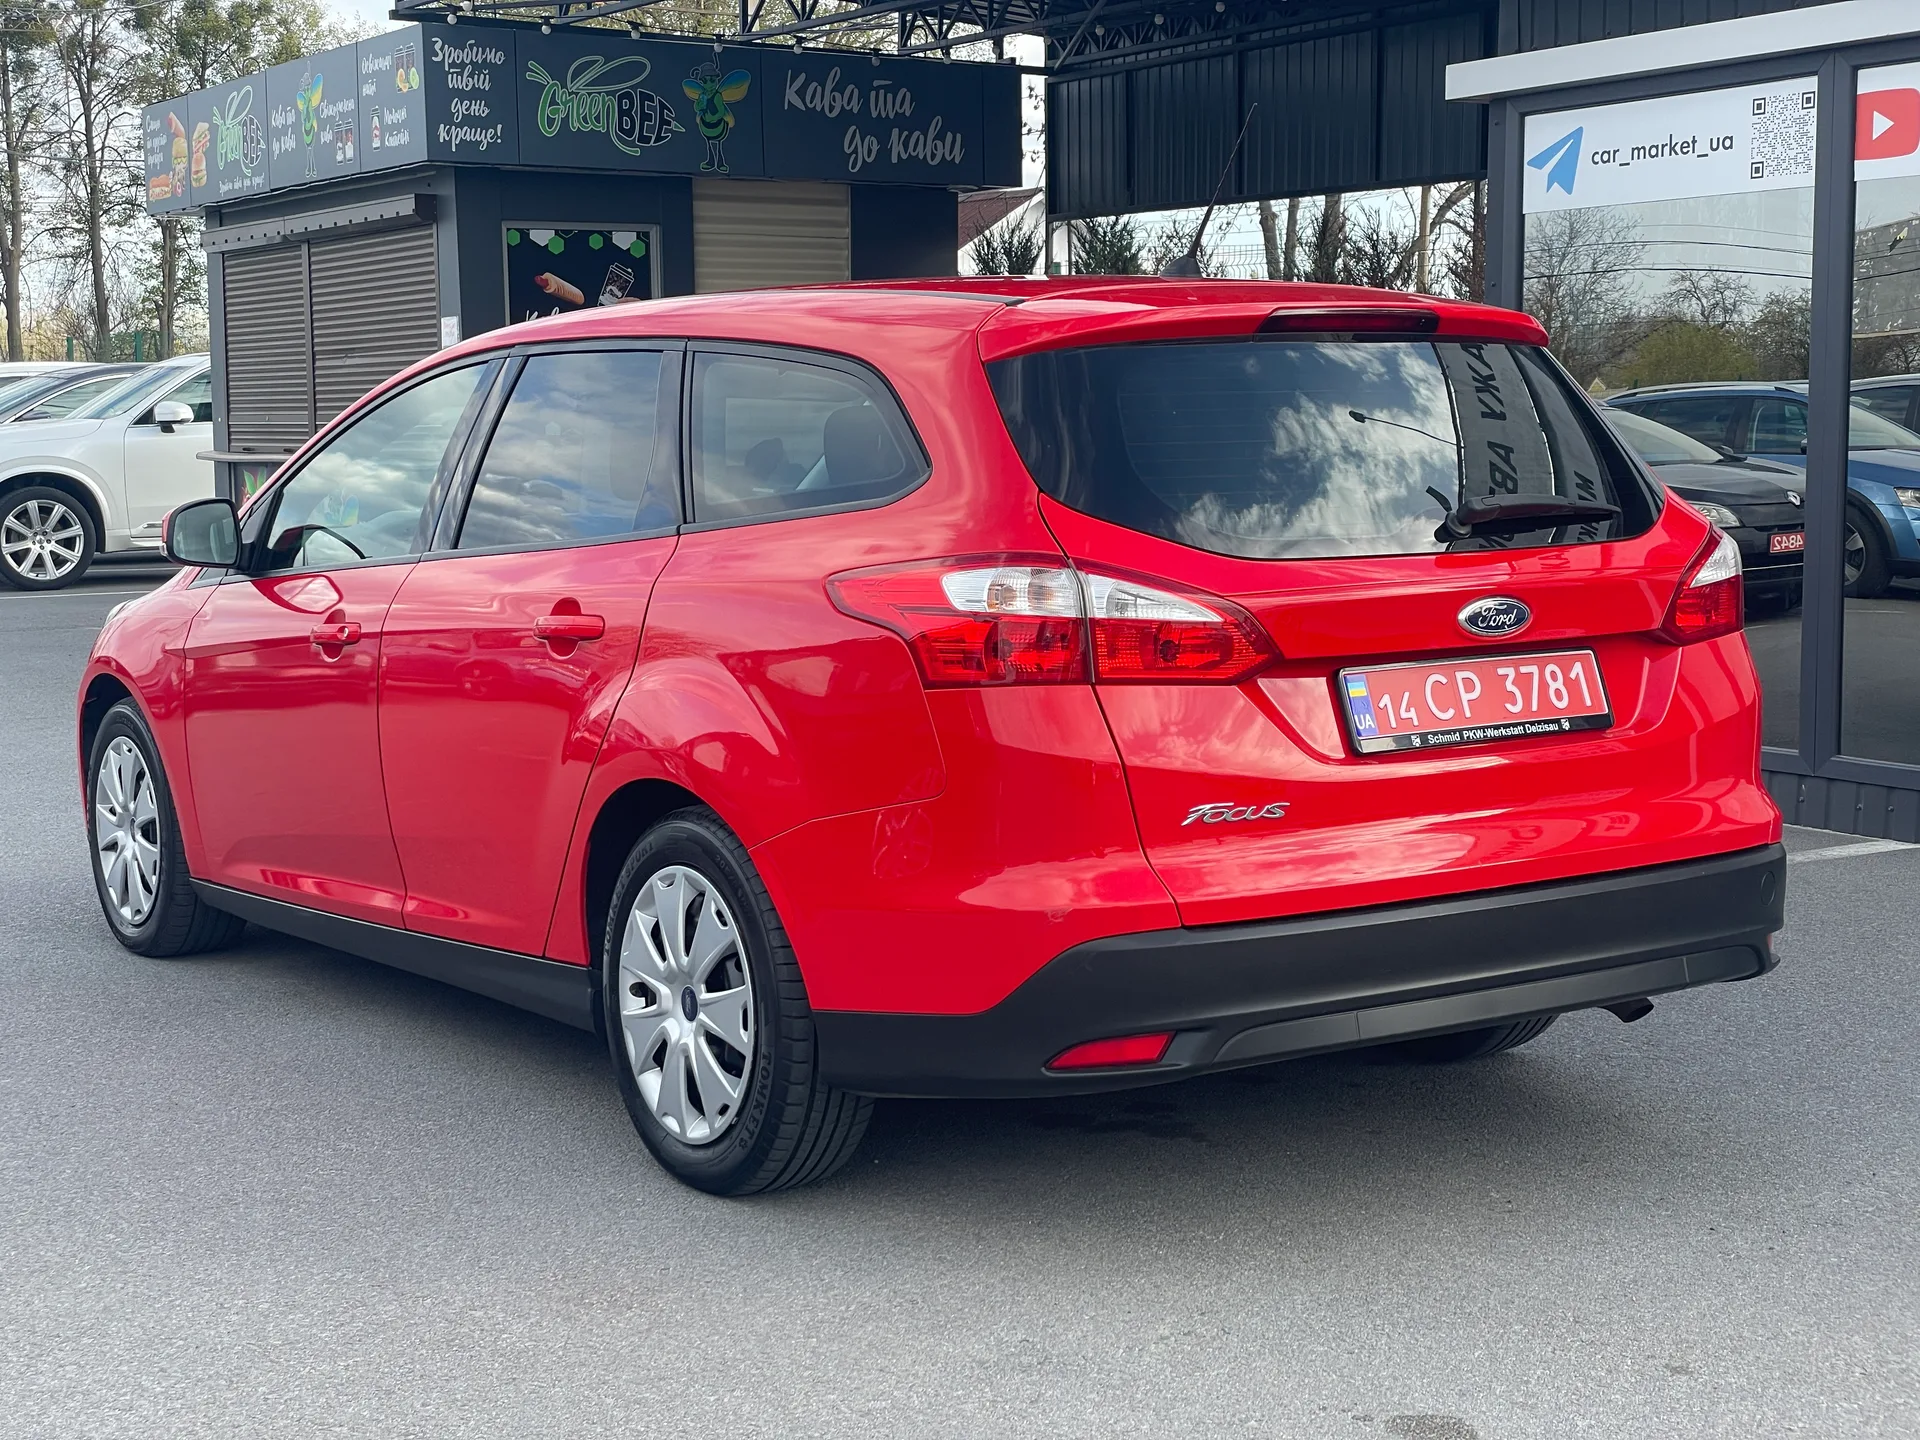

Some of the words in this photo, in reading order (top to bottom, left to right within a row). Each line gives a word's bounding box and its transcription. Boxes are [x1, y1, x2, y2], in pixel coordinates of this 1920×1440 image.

[431, 37, 506, 71] Зробимо
[447, 64, 492, 91] твій
[783, 66, 864, 118] Кава
[869, 79, 916, 120] та
[450, 97, 491, 123] день
[436, 124, 503, 152] краще!
[843, 124, 881, 173] до
[887, 115, 966, 166] кави
[1590, 132, 1735, 168] car_market_ua
[1477, 604, 1518, 628] Ford
[1377, 690, 1420, 730] 14
[1424, 669, 1483, 722] CP
[1496, 660, 1593, 715] 3781
[1354, 713, 1375, 730] UA
[1427, 731, 1461, 745] Schmid
[1463, 724, 1525, 741] PKW-Werkstatt
